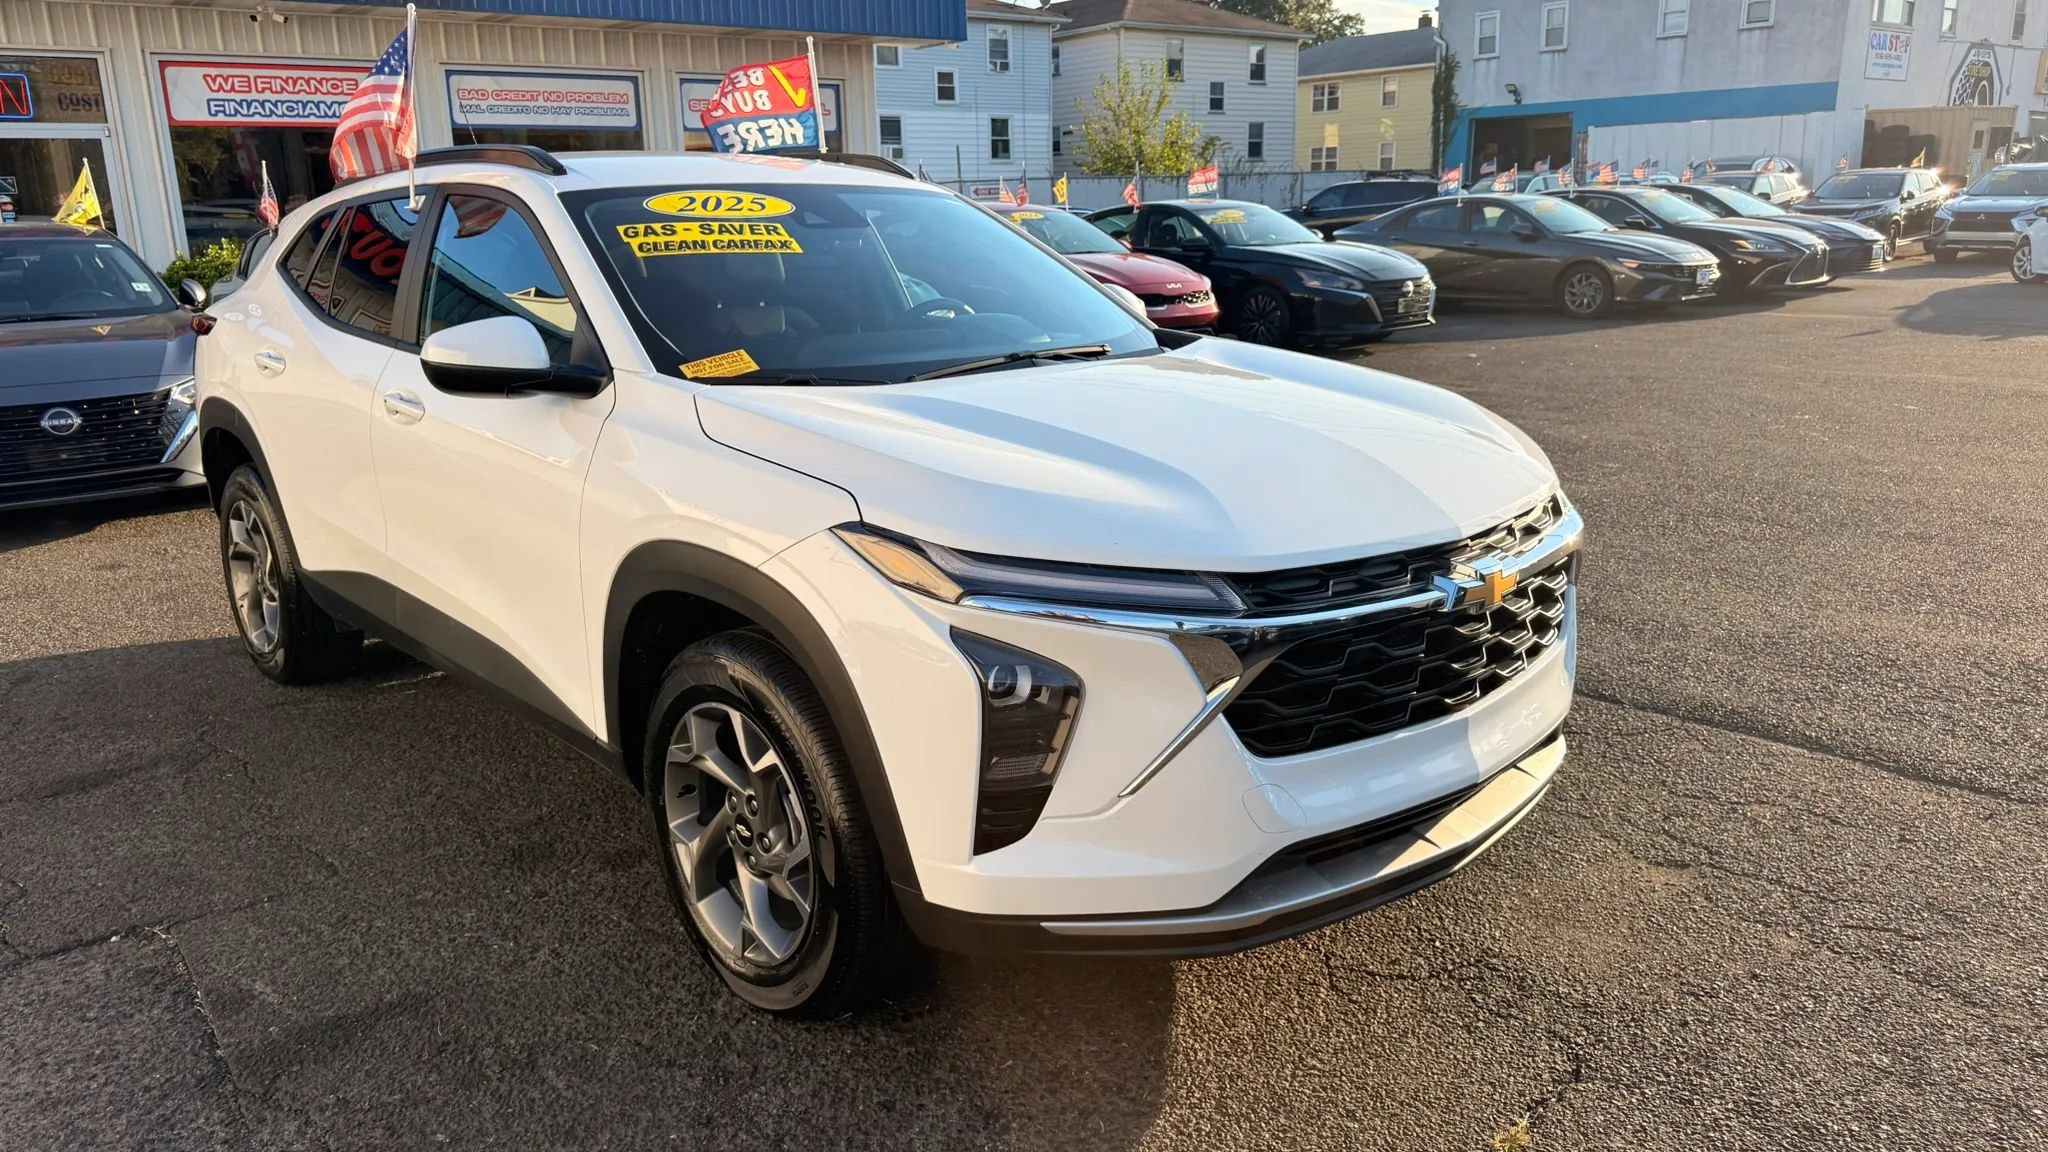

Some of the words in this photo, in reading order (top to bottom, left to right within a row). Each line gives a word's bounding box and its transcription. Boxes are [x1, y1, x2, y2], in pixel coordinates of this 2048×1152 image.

[203, 74, 250, 92] WE
[254, 75, 358, 96] FINANCE
[457, 89, 489, 100] BAD
[491, 89, 541, 102] CREDIT
[544, 90, 565, 102] NO
[567, 91, 629, 104] PROBLEM
[460, 104, 485, 113] MAL
[487, 104, 531, 114] CREDITO
[532, 105, 549, 115] NO
[551, 105, 573, 116] HAY
[574, 106, 630, 117] PROBLEMA
[677, 195, 767, 213] 2025
[623, 223, 677, 239] GAS
[698, 223, 785, 236] SAVER
[637, 239, 710, 253] CLEAN
[712, 239, 793, 251] CARFAX
[687, 360, 706, 370] THIS
[706, 351, 744, 364] VEHICLE
[708, 362, 725, 370] FOR
[725, 357, 746, 365] SALE
[40, 418, 82, 427] NISSAN
